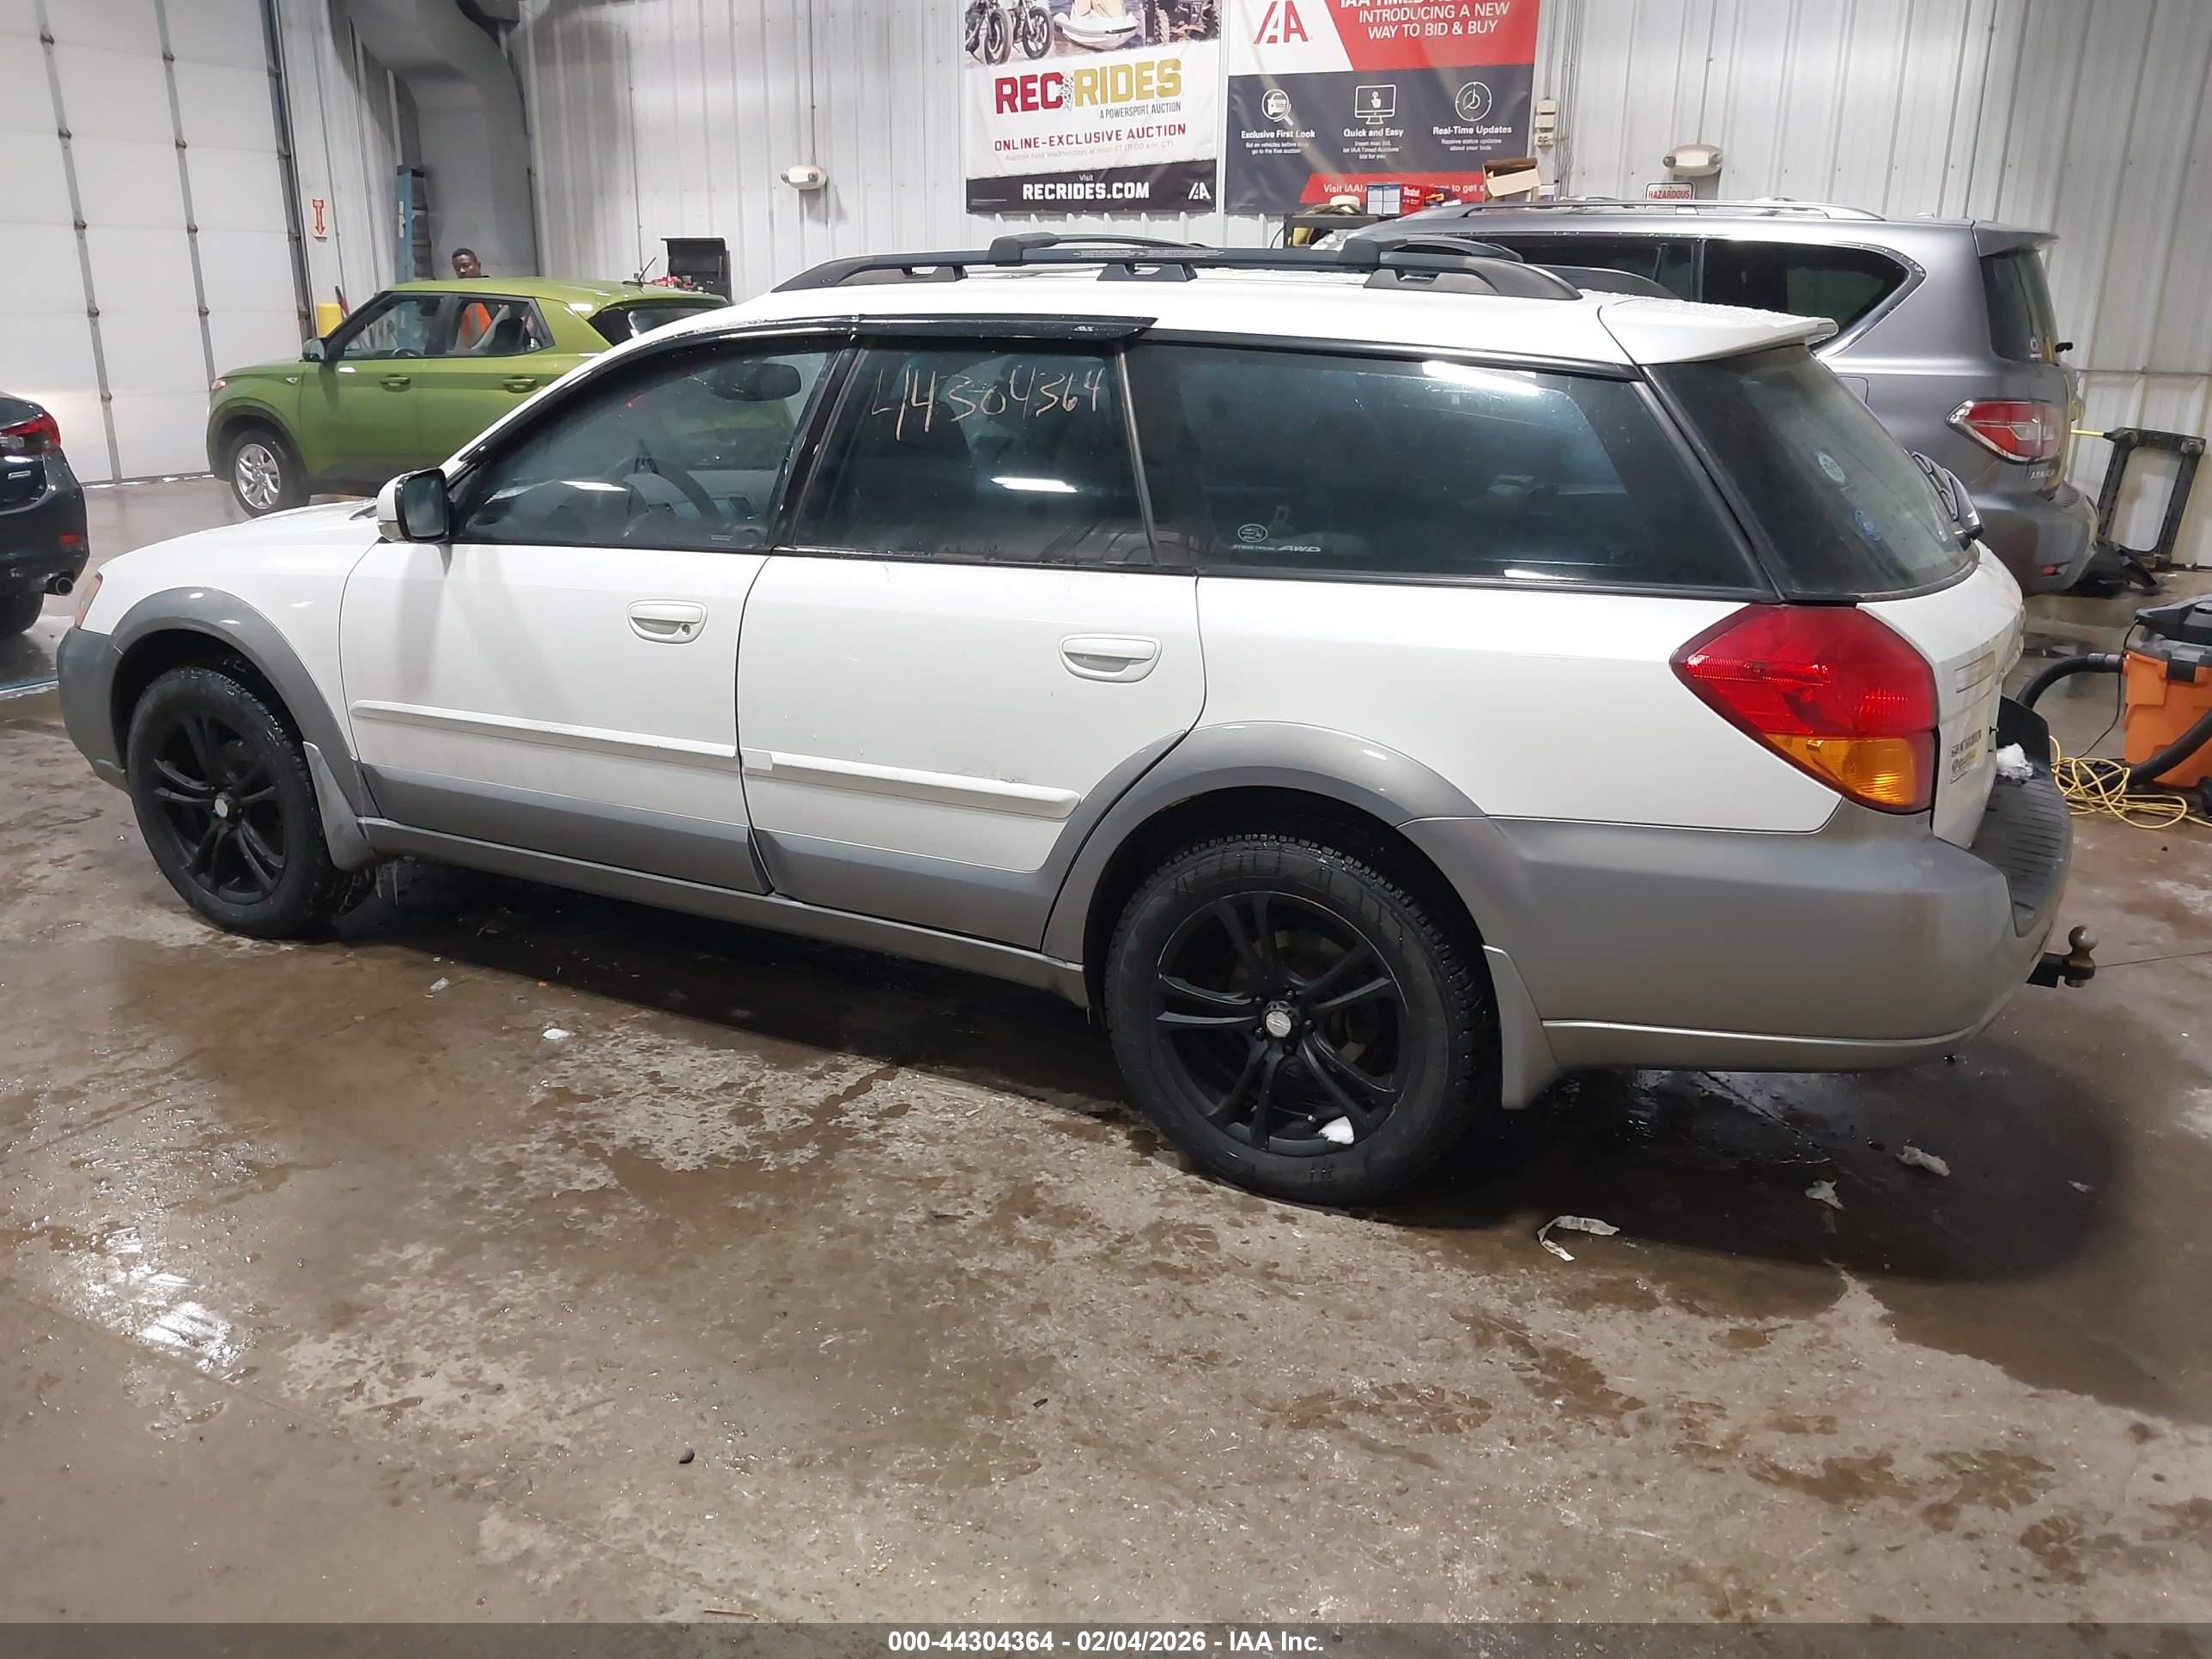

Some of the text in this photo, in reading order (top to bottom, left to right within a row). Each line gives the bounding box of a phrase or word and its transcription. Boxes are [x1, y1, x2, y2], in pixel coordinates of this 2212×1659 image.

[1358, 2, 1510, 24] INTRODUCING A NEW
[1367, 20, 1498, 40] WAY TO BID & BUY
[995, 58, 1182, 114] REC RIDES
[1099, 102, 1182, 119] A POWERSPORT AUCTION
[994, 124, 1186, 151] ONLINE-EXCLUSIVE AUCTION
[1241, 129, 1316, 138] Exclusive First Look
[1343, 127, 1404, 137] Quick and Easy
[1432, 125, 1512, 135] Real-Time Updates
[1023, 182, 1150, 200] RECRIDES.COM
[1323, 184, 1342, 193] Visit
[1462, 185, 1477, 194] get
[1648, 190, 1691, 199] HAZARDOUS
[871, 364, 1106, 441] 44304364
